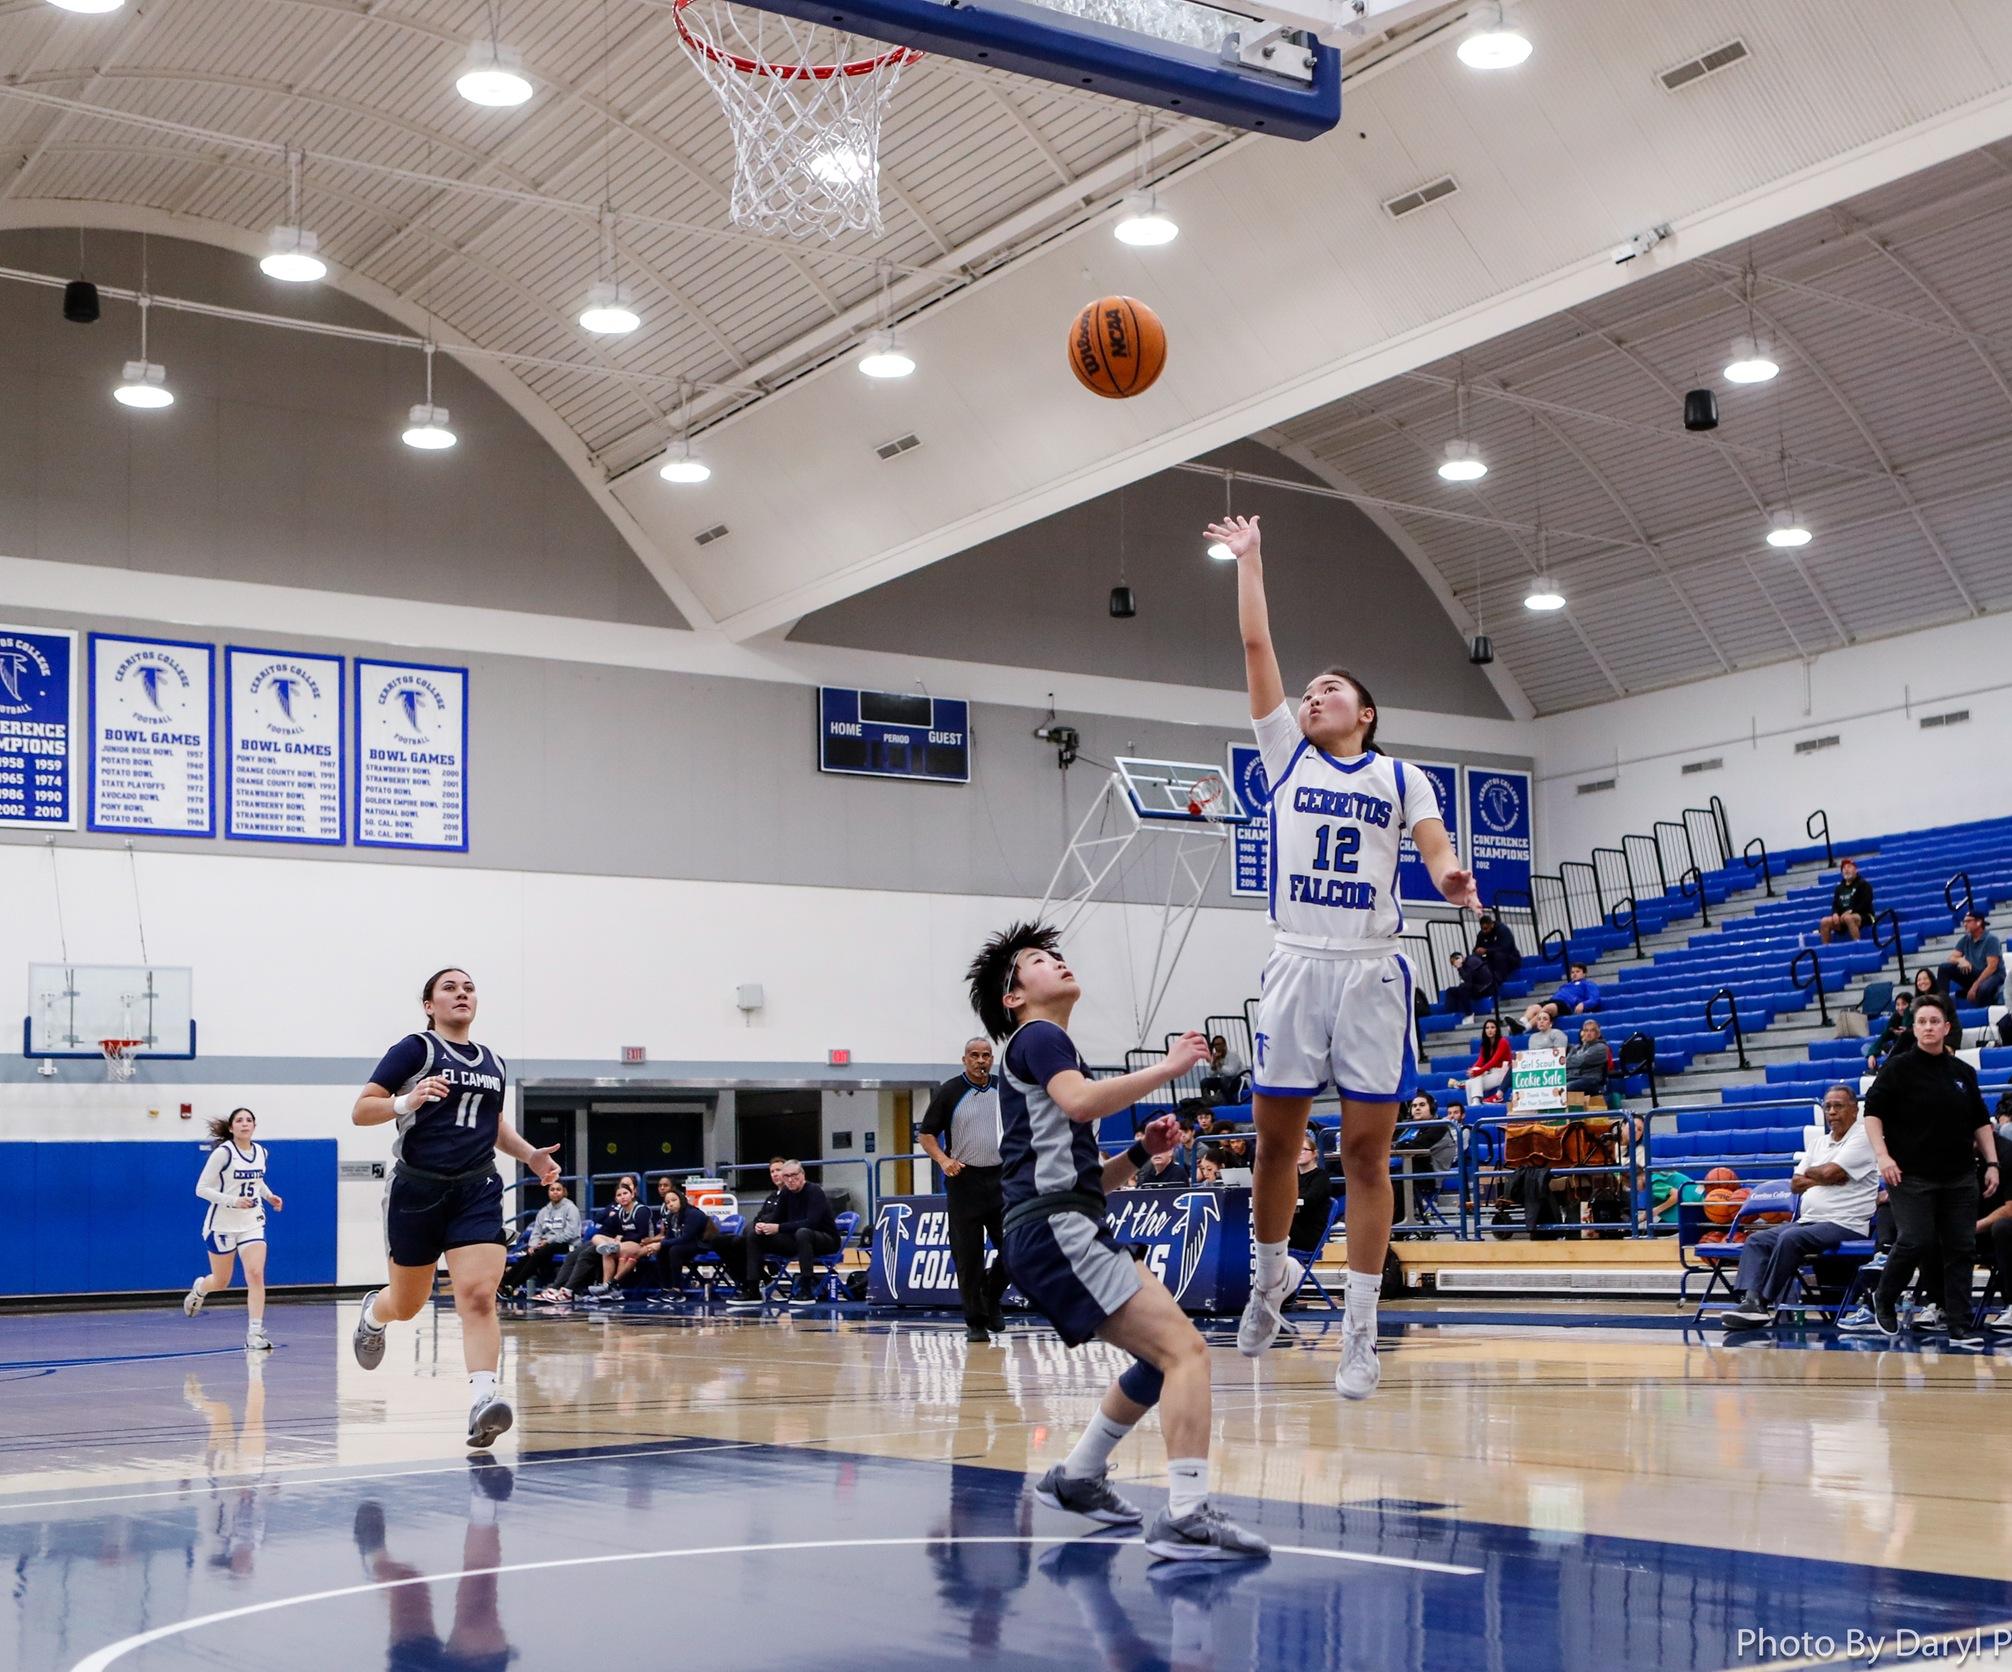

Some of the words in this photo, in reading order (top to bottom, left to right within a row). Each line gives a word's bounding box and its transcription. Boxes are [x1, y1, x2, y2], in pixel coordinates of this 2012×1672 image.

[1105, 308, 1128, 358] NCAA
[115, 651, 155, 682] CERRITOS
[157, 653, 190, 688] COLLEGE
[250, 664, 287, 694] CERRITOS
[290, 665, 321, 699] COLLEGE
[378, 676, 413, 705] CERRITOS
[416, 677, 445, 710] COLLEGE
[0, 720, 66, 738] ERENCE
[830, 721, 862, 737] HOME
[883, 733, 909, 744] PERIOD
[928, 730, 963, 745] GUEST
[104, 729, 147, 743] BOWL
[151, 732, 200, 746] GAMES
[0, 737, 66, 756] MPIONS
[153, 748, 174, 756] BOWL
[241, 739, 281, 752] BOWL
[285, 743, 331, 756] GAMES
[101, 756, 131, 765] POTATO
[133, 758, 153, 767] BOWL
[257, 756, 277, 764] BOWL
[369, 749, 407, 762] BOWL
[411, 752, 455, 765] GAMES
[34, 759, 62, 771] 1959
[366, 764, 410, 774] STRAWBERRY
[101, 768, 131, 776] POTATO
[133, 770, 153, 778] BOWL
[236, 766, 264, 774] ORANGE
[266, 768, 295, 777] COUNTY
[297, 770, 316, 778] BOWL
[34, 774, 62, 787] 1974
[101, 779, 124, 788] STATE
[127, 781, 165, 790] PLAYOFFS
[236, 777, 264, 785] ORANGE
[266, 779, 295, 788] COUNTY
[297, 781, 316, 789] BOWL
[366, 775, 410, 784] STRAWBERRY
[412, 778, 431, 786] BOWL
[34, 790, 62, 802] 1990
[101, 791, 137, 799] AVOCADO
[139, 793, 159, 801] BOWL
[236, 789, 284, 798] STRAWBERRY
[286, 792, 305, 800] BOWL
[365, 786, 391, 794] POTATO
[123, 804, 144, 812] BOWL
[236, 800, 284, 809] STRAWBERRY
[286, 803, 305, 811] BOWL
[365, 797, 391, 805] GOLDEN
[393, 799, 417, 807] EMPIRE
[1294, 786, 1392, 829] CERRITOS
[34, 805, 63, 818] 2010
[236, 811, 284, 820] STRAWBERRY
[286, 814, 305, 822] BOWL
[365, 808, 398, 816] NATIONAL
[400, 810, 419, 818] BOWL
[101, 814, 131, 822] POTATO
[133, 816, 153, 825] BOWL
[236, 822, 284, 831] STRAWBERRY
[286, 825, 306, 833] BOWL
[395, 831, 414, 839] BOWL
[1473, 834, 1529, 848] CONFERENCE
[1312, 824, 1361, 874] 12
[1473, 846, 1530, 861] CHAMPIONS
[441, 1068, 458, 1084] EL
[461, 1071, 501, 1093] CAMINO
[1516, 1072, 1540, 1088] Cookie
[1543, 1070, 1562, 1086] Sale
[455, 1092, 483, 1129] 11
[239, 1182, 255, 1197] 15
[1131, 1200, 1172, 1239] the
